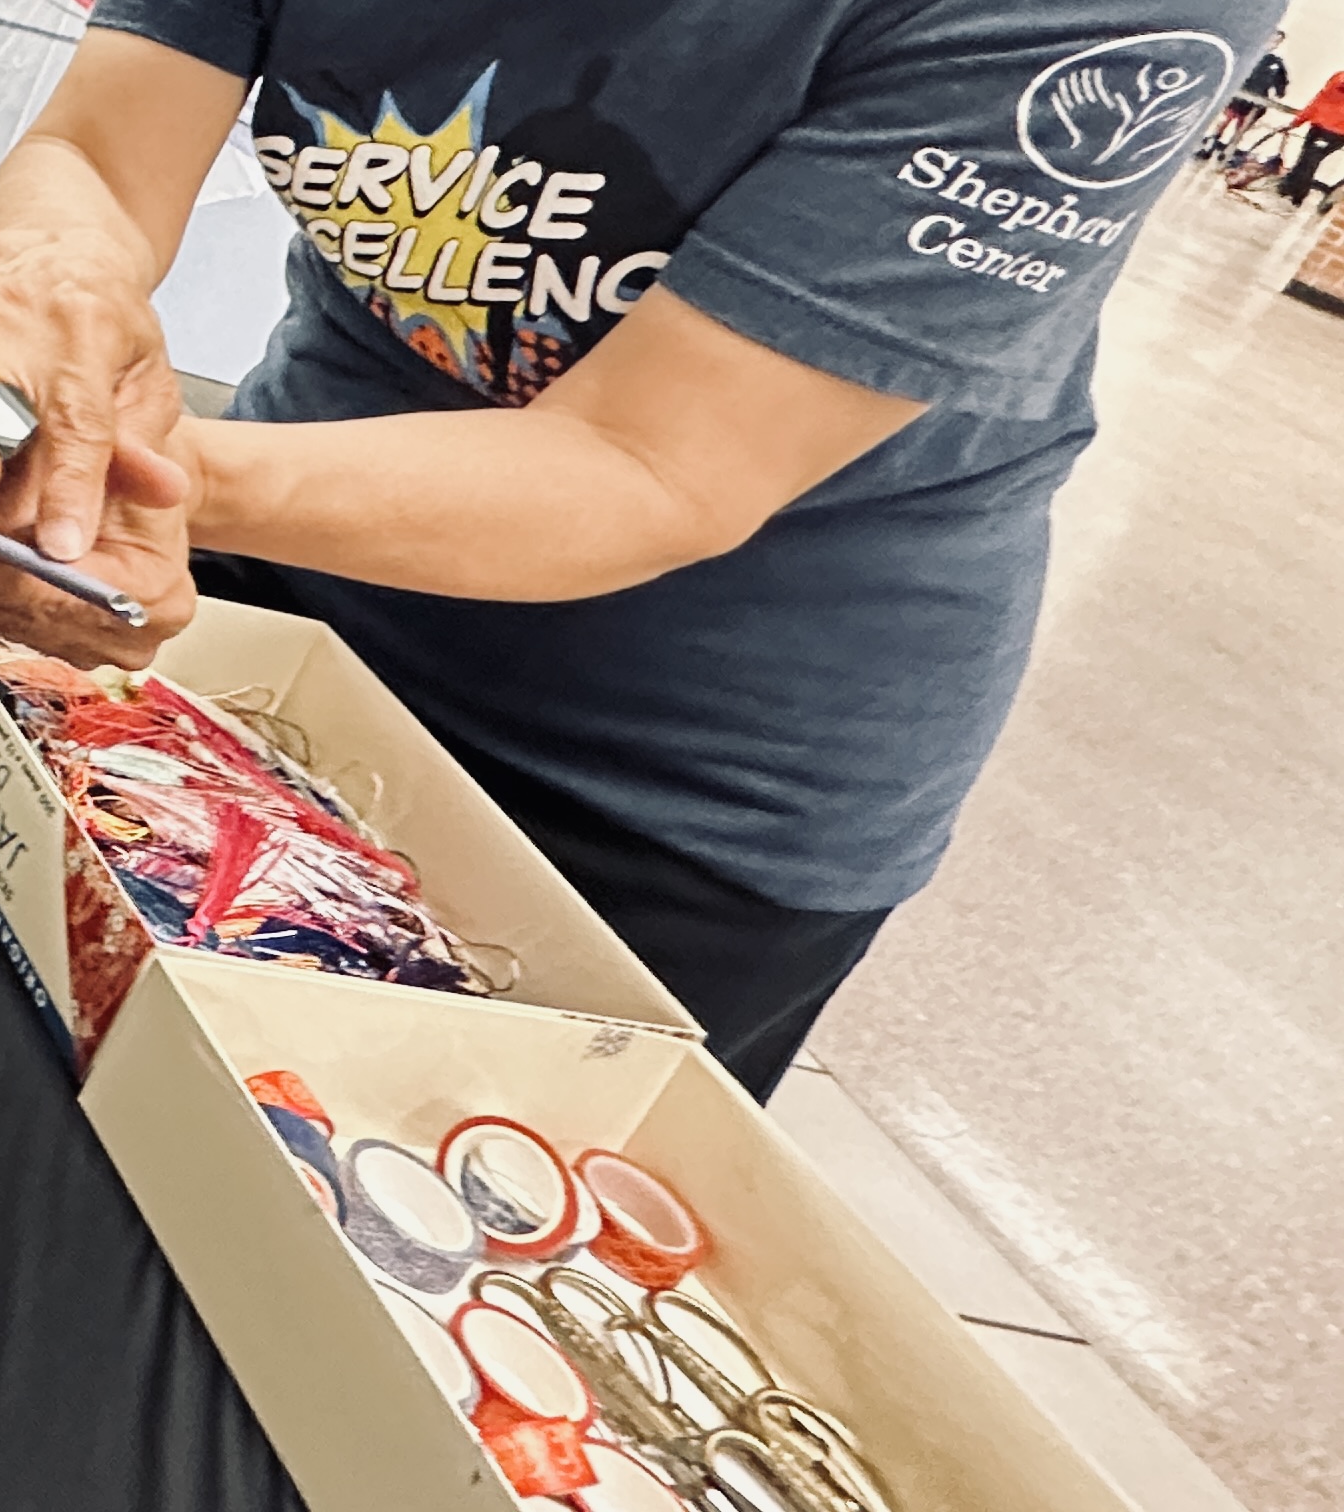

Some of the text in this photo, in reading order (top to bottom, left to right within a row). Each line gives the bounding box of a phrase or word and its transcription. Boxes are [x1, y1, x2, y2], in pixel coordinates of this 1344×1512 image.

[254, 134, 606, 241] SERVICE
[304, 216, 672, 323] CELLENC
[907, 214, 1067, 293] Center
